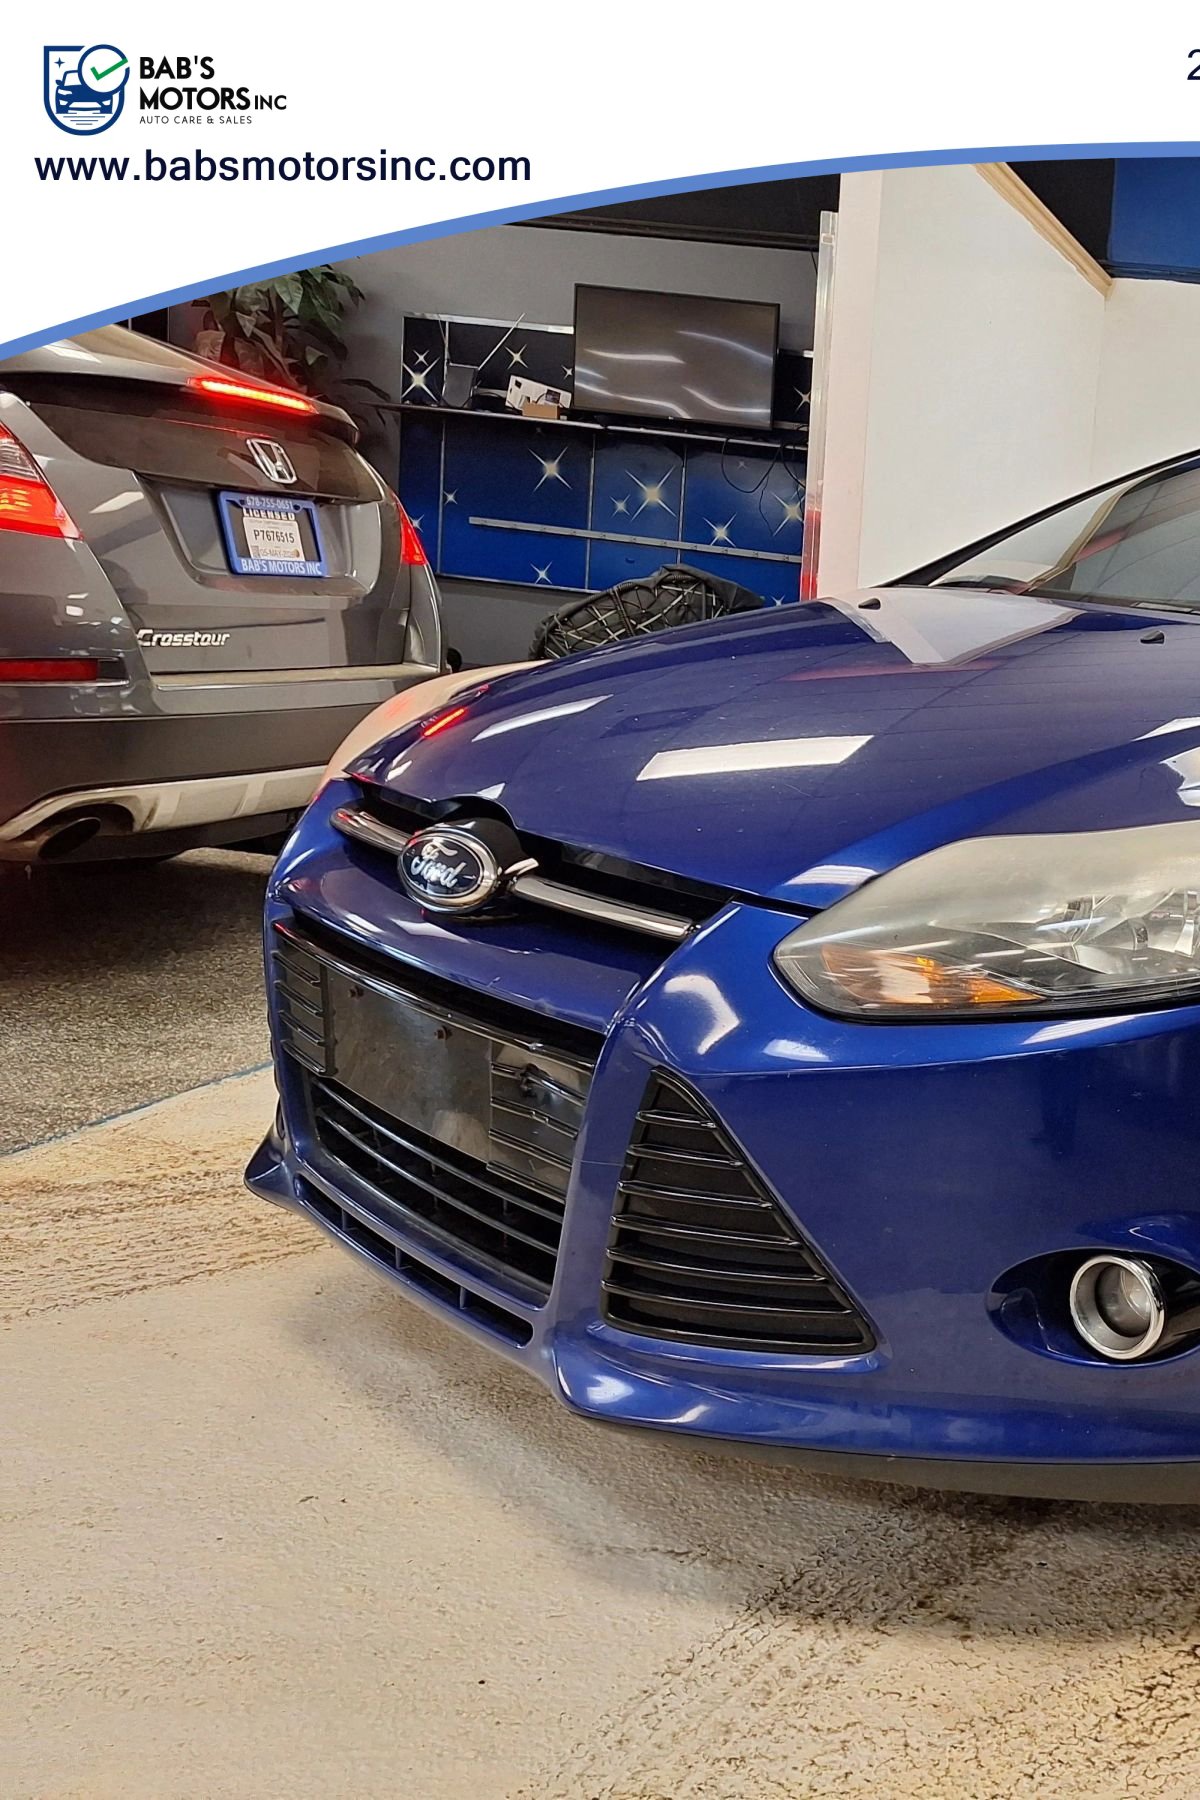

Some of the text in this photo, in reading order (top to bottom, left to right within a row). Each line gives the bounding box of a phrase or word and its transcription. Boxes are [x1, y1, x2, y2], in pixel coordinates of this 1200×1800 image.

[246, 496, 294, 509] 678-755-0651
[253, 529, 295, 543] P7676515
[241, 559, 322, 575] BAB'S MOTORS INC
[137, 628, 230, 647] Crosstour
[411, 839, 468, 889] Ford
